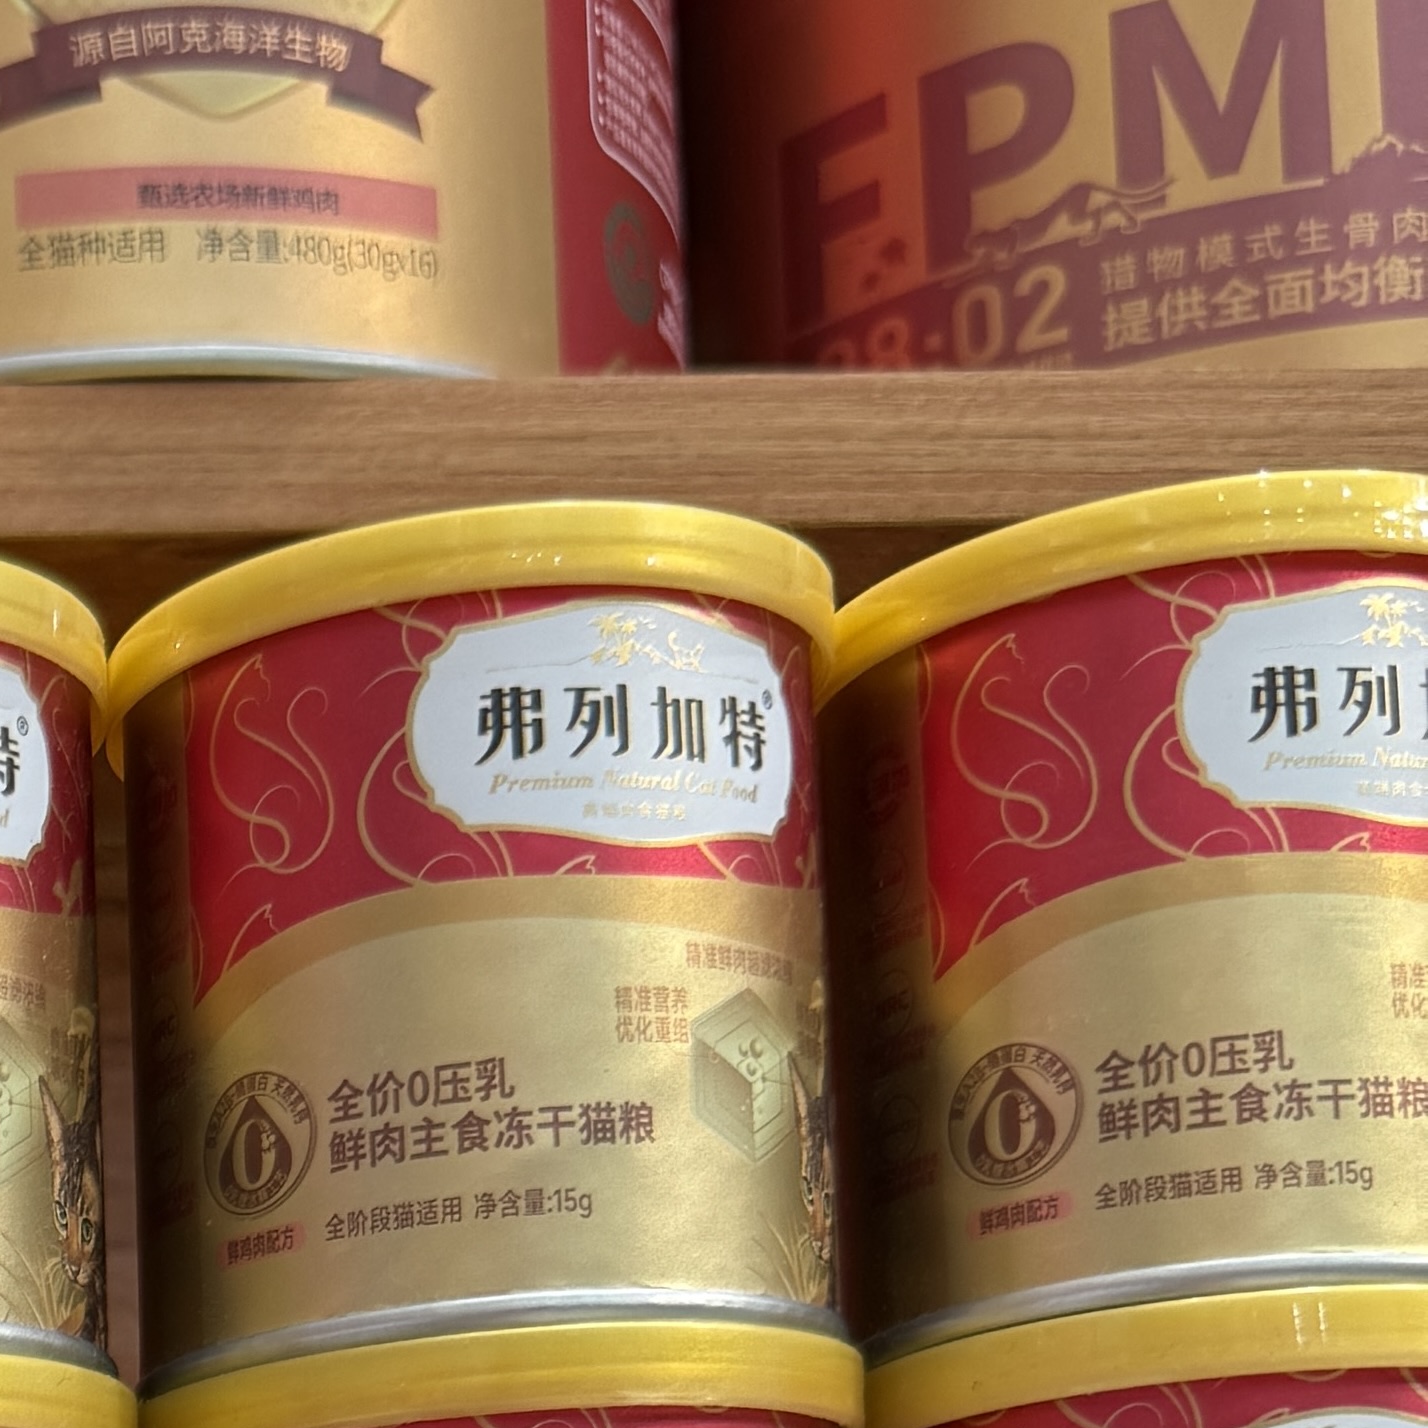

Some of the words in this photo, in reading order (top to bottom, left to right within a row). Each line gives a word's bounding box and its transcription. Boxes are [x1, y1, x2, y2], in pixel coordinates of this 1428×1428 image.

[69, 18, 352, 74] 源自阿克海洋生物
[136, 179, 340, 217] 甄选农场新鲜鸡肉
[17, 228, 167, 271] 全猫种适用
[476, 682, 766, 771] 弗列加特
[1095, 1030, 1293, 1094] 全价0压乳
[326, 1057, 515, 1124] 全价0压乳
[328, 1101, 655, 1173] 鲜肉主食冻干猫粮
[1095, 1166, 1243, 1211] 全阶段猫适用
[1253, 1160, 1373, 1190] 净含量:15g
[325, 1197, 463, 1242] 全阶段猫适用
[474, 1188, 593, 1221] 净含量:15g
